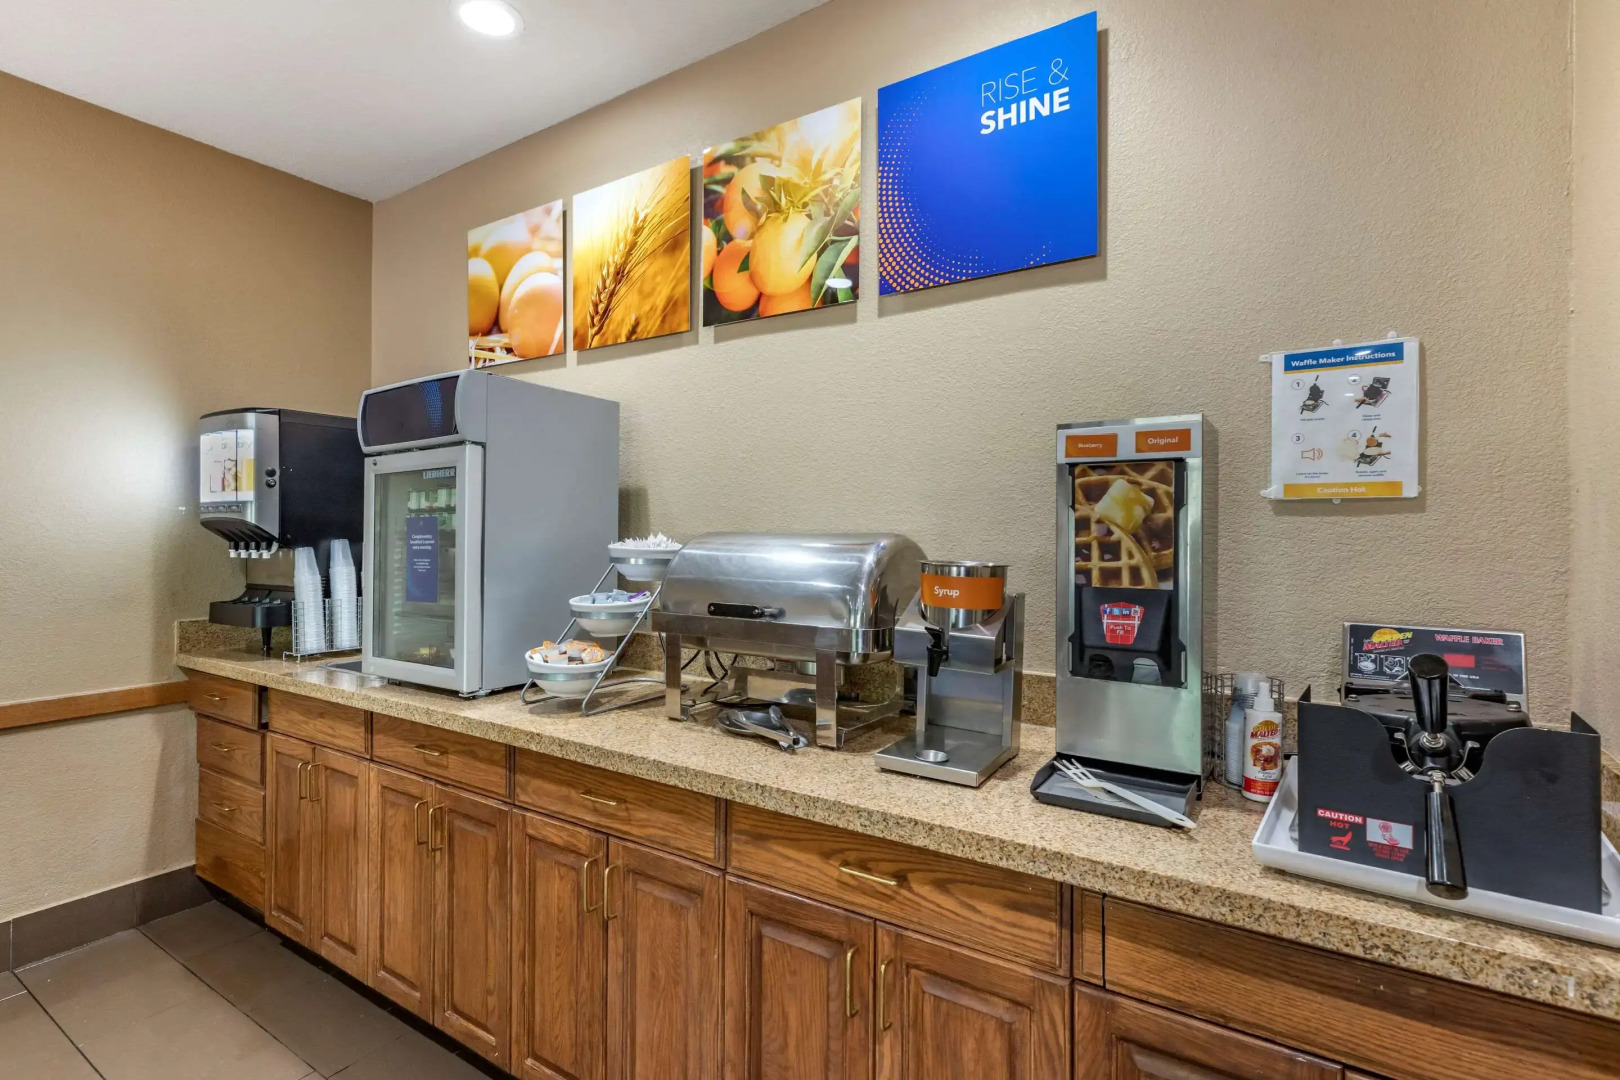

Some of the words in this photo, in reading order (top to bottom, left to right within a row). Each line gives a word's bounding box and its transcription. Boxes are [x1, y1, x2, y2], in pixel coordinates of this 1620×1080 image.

[981, 66, 1038, 107] RISE
[1048, 58, 1069, 86] &
[980, 86, 1071, 135] SHINE
[1291, 357, 1317, 367] Waffle
[1319, 355, 1345, 365] Maker
[1346, 350, 1396, 362] Instructions
[1147, 436, 1179, 446] Original
[423, 468, 456, 479] LIEBHERR
[1317, 486, 1349, 494] Caution
[934, 585, 960, 598] Syrup
[1434, 633, 1470, 643] WAFFLE
[1471, 636, 1504, 646] BAKER
[1317, 809, 1363, 824] CAUTION
[1329, 820, 1351, 829] HOT
